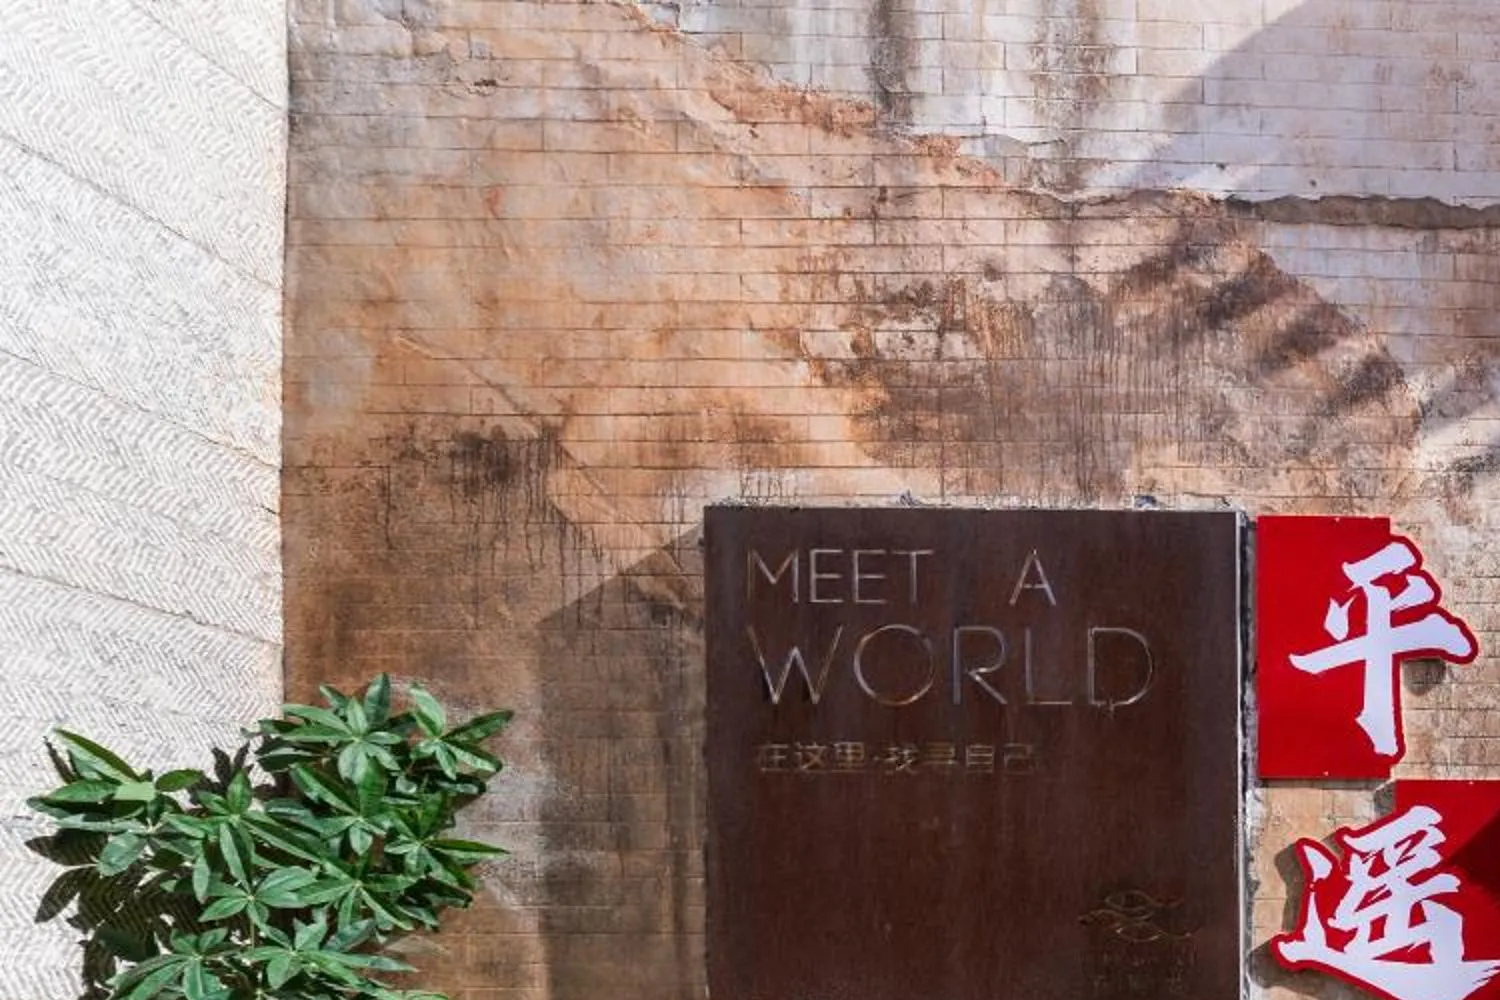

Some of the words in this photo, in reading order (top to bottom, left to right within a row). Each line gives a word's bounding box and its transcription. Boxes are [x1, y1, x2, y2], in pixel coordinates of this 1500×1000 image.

[746, 547, 935, 605] MEET
[1008, 548, 1058, 606] A
[746, 623, 1156, 708] WORLD
